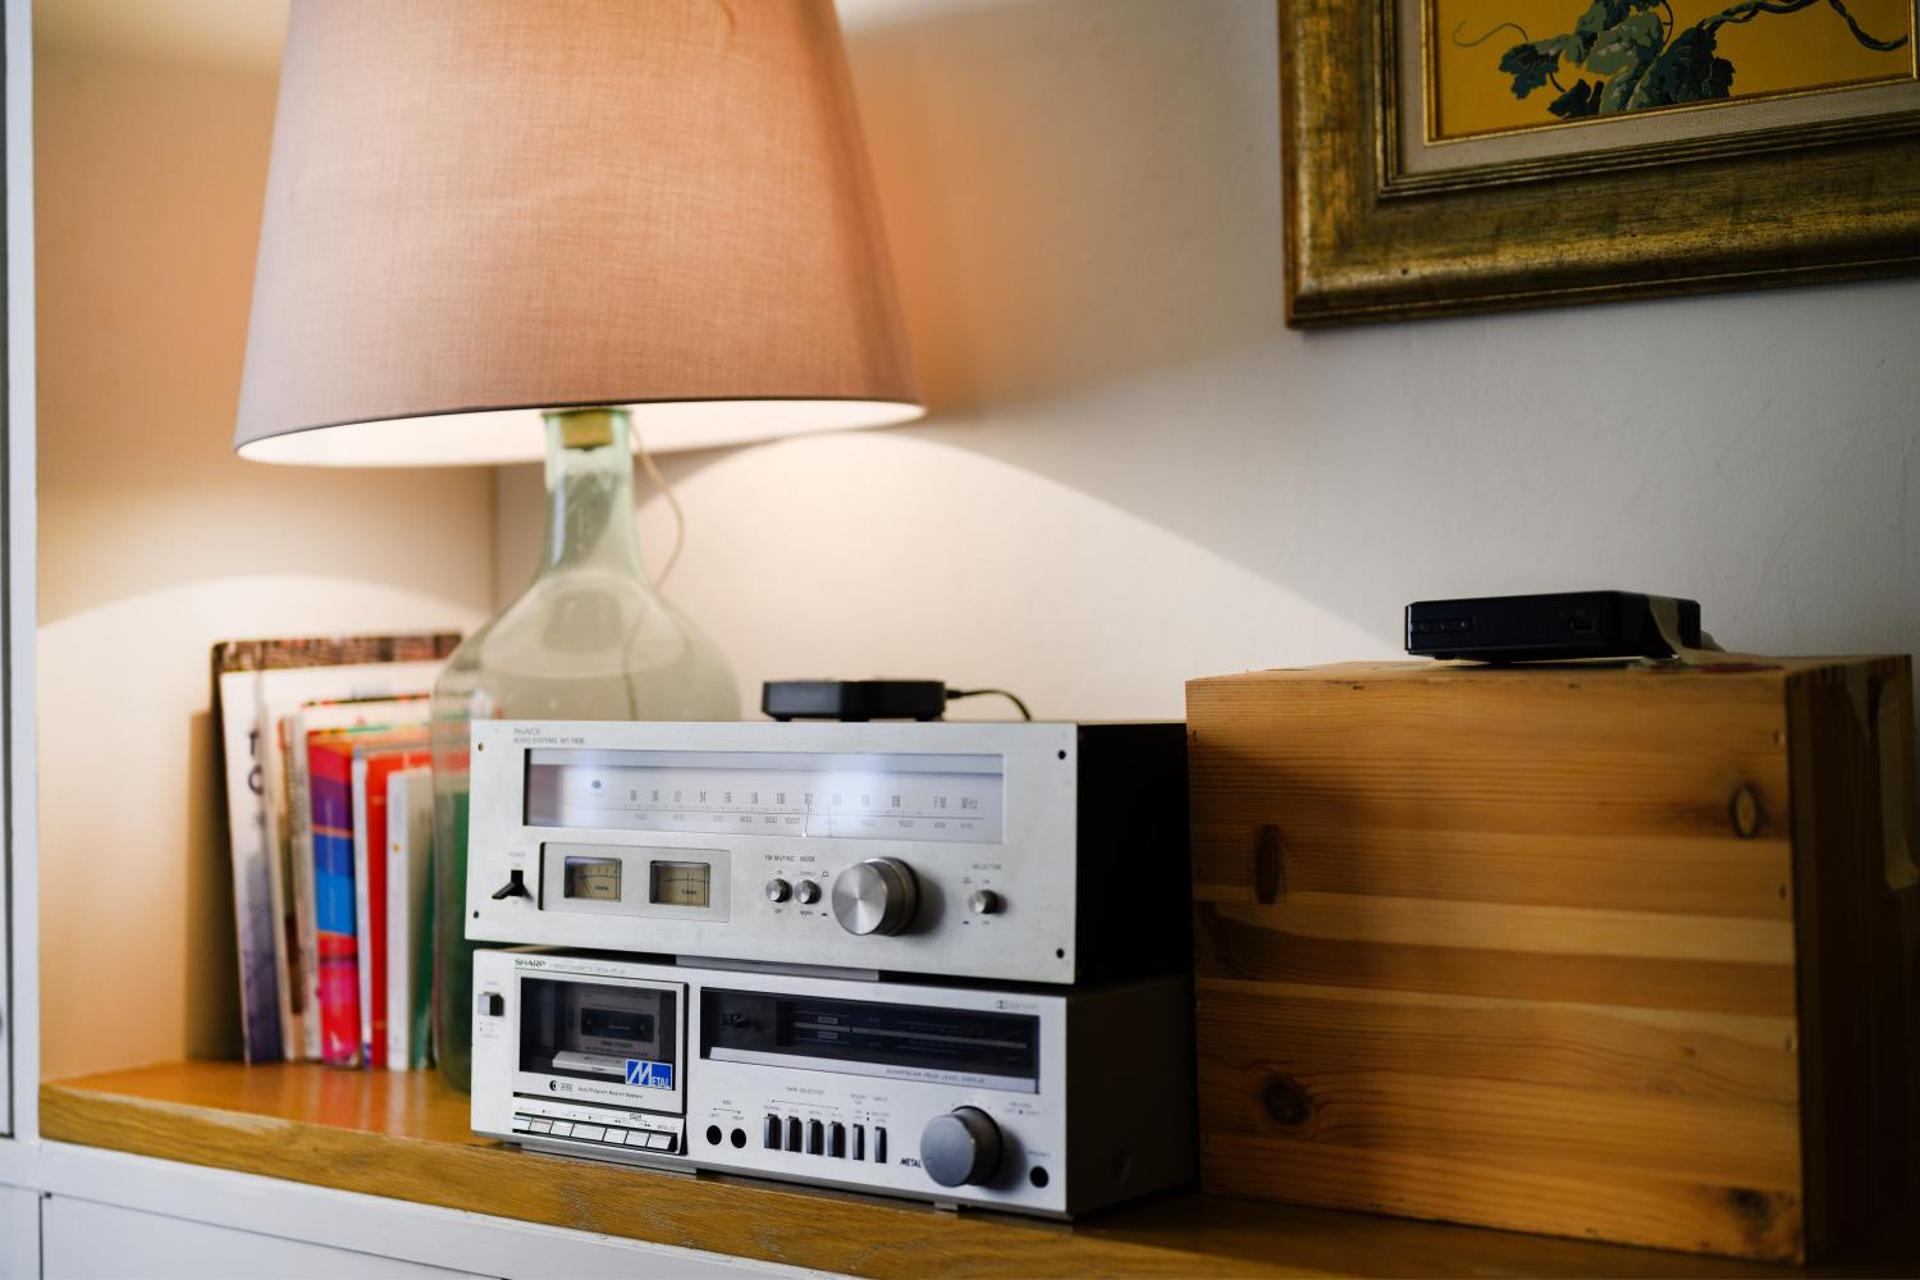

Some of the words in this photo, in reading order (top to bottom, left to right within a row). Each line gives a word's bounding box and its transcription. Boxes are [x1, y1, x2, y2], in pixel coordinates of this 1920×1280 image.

[515, 958, 546, 968] SHARP
[628, 1060, 671, 1088] METAL
[900, 1157, 922, 1168] METAL
